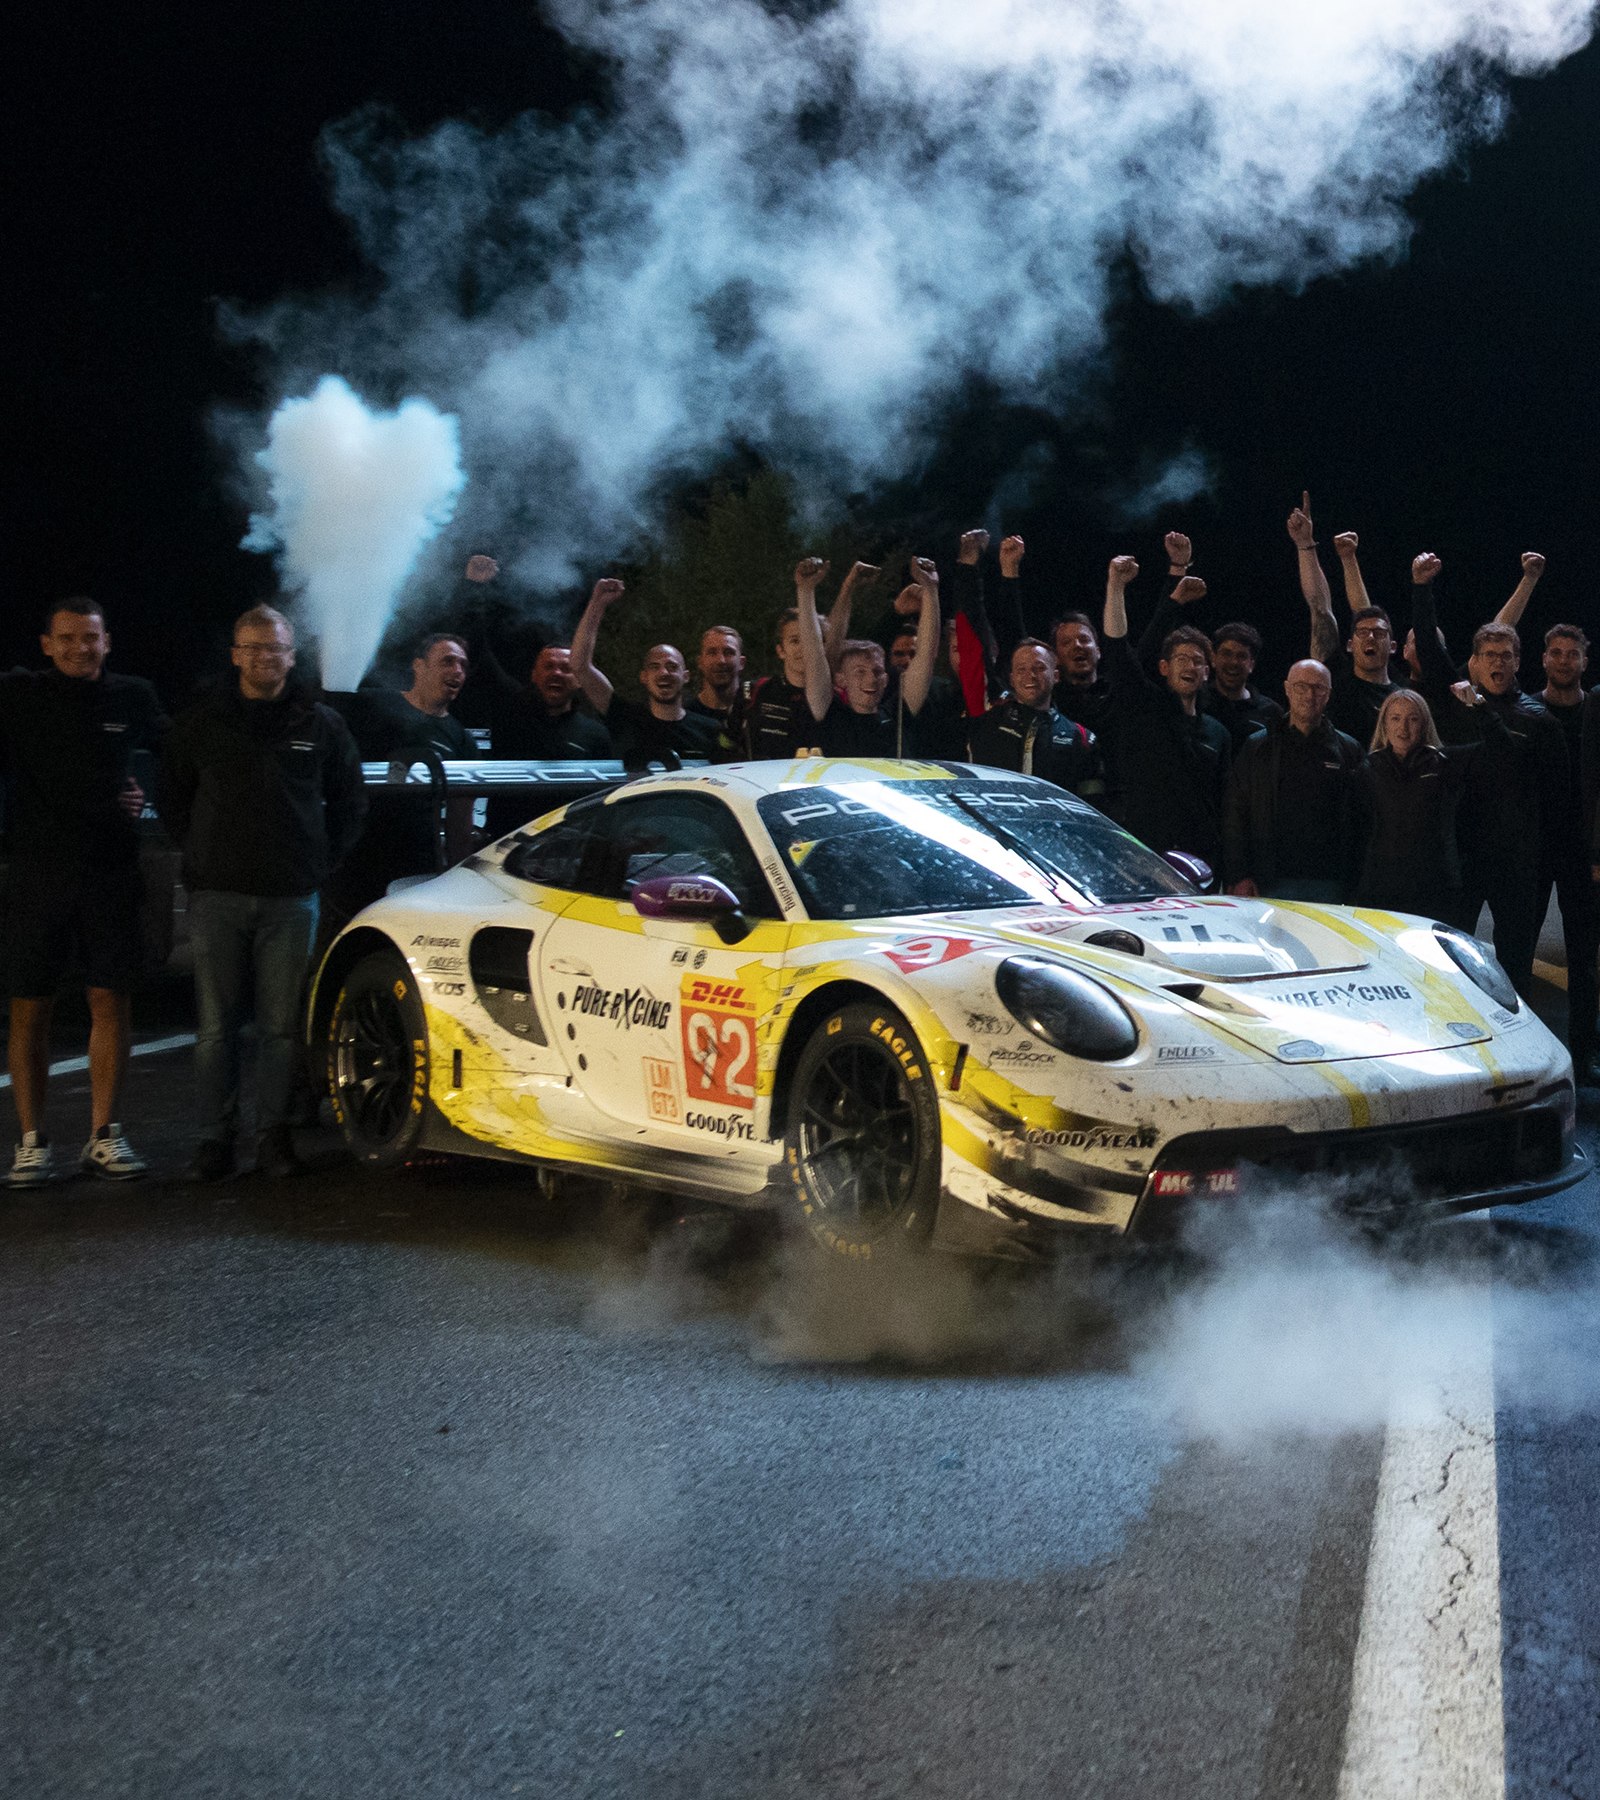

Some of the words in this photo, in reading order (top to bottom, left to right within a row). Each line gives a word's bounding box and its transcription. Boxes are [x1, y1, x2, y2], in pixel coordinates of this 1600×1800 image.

[691, 981, 746, 1008] DHL
[687, 1012, 756, 1099] 92
[869, 1016, 923, 1082] EAGLE
[1158, 1046, 1216, 1059] ENDLESS
[686, 1111, 776, 1146] GOODYE
[1026, 1126, 1155, 1150] GOODYEAR
[1158, 1174, 1238, 1193] MOUL
